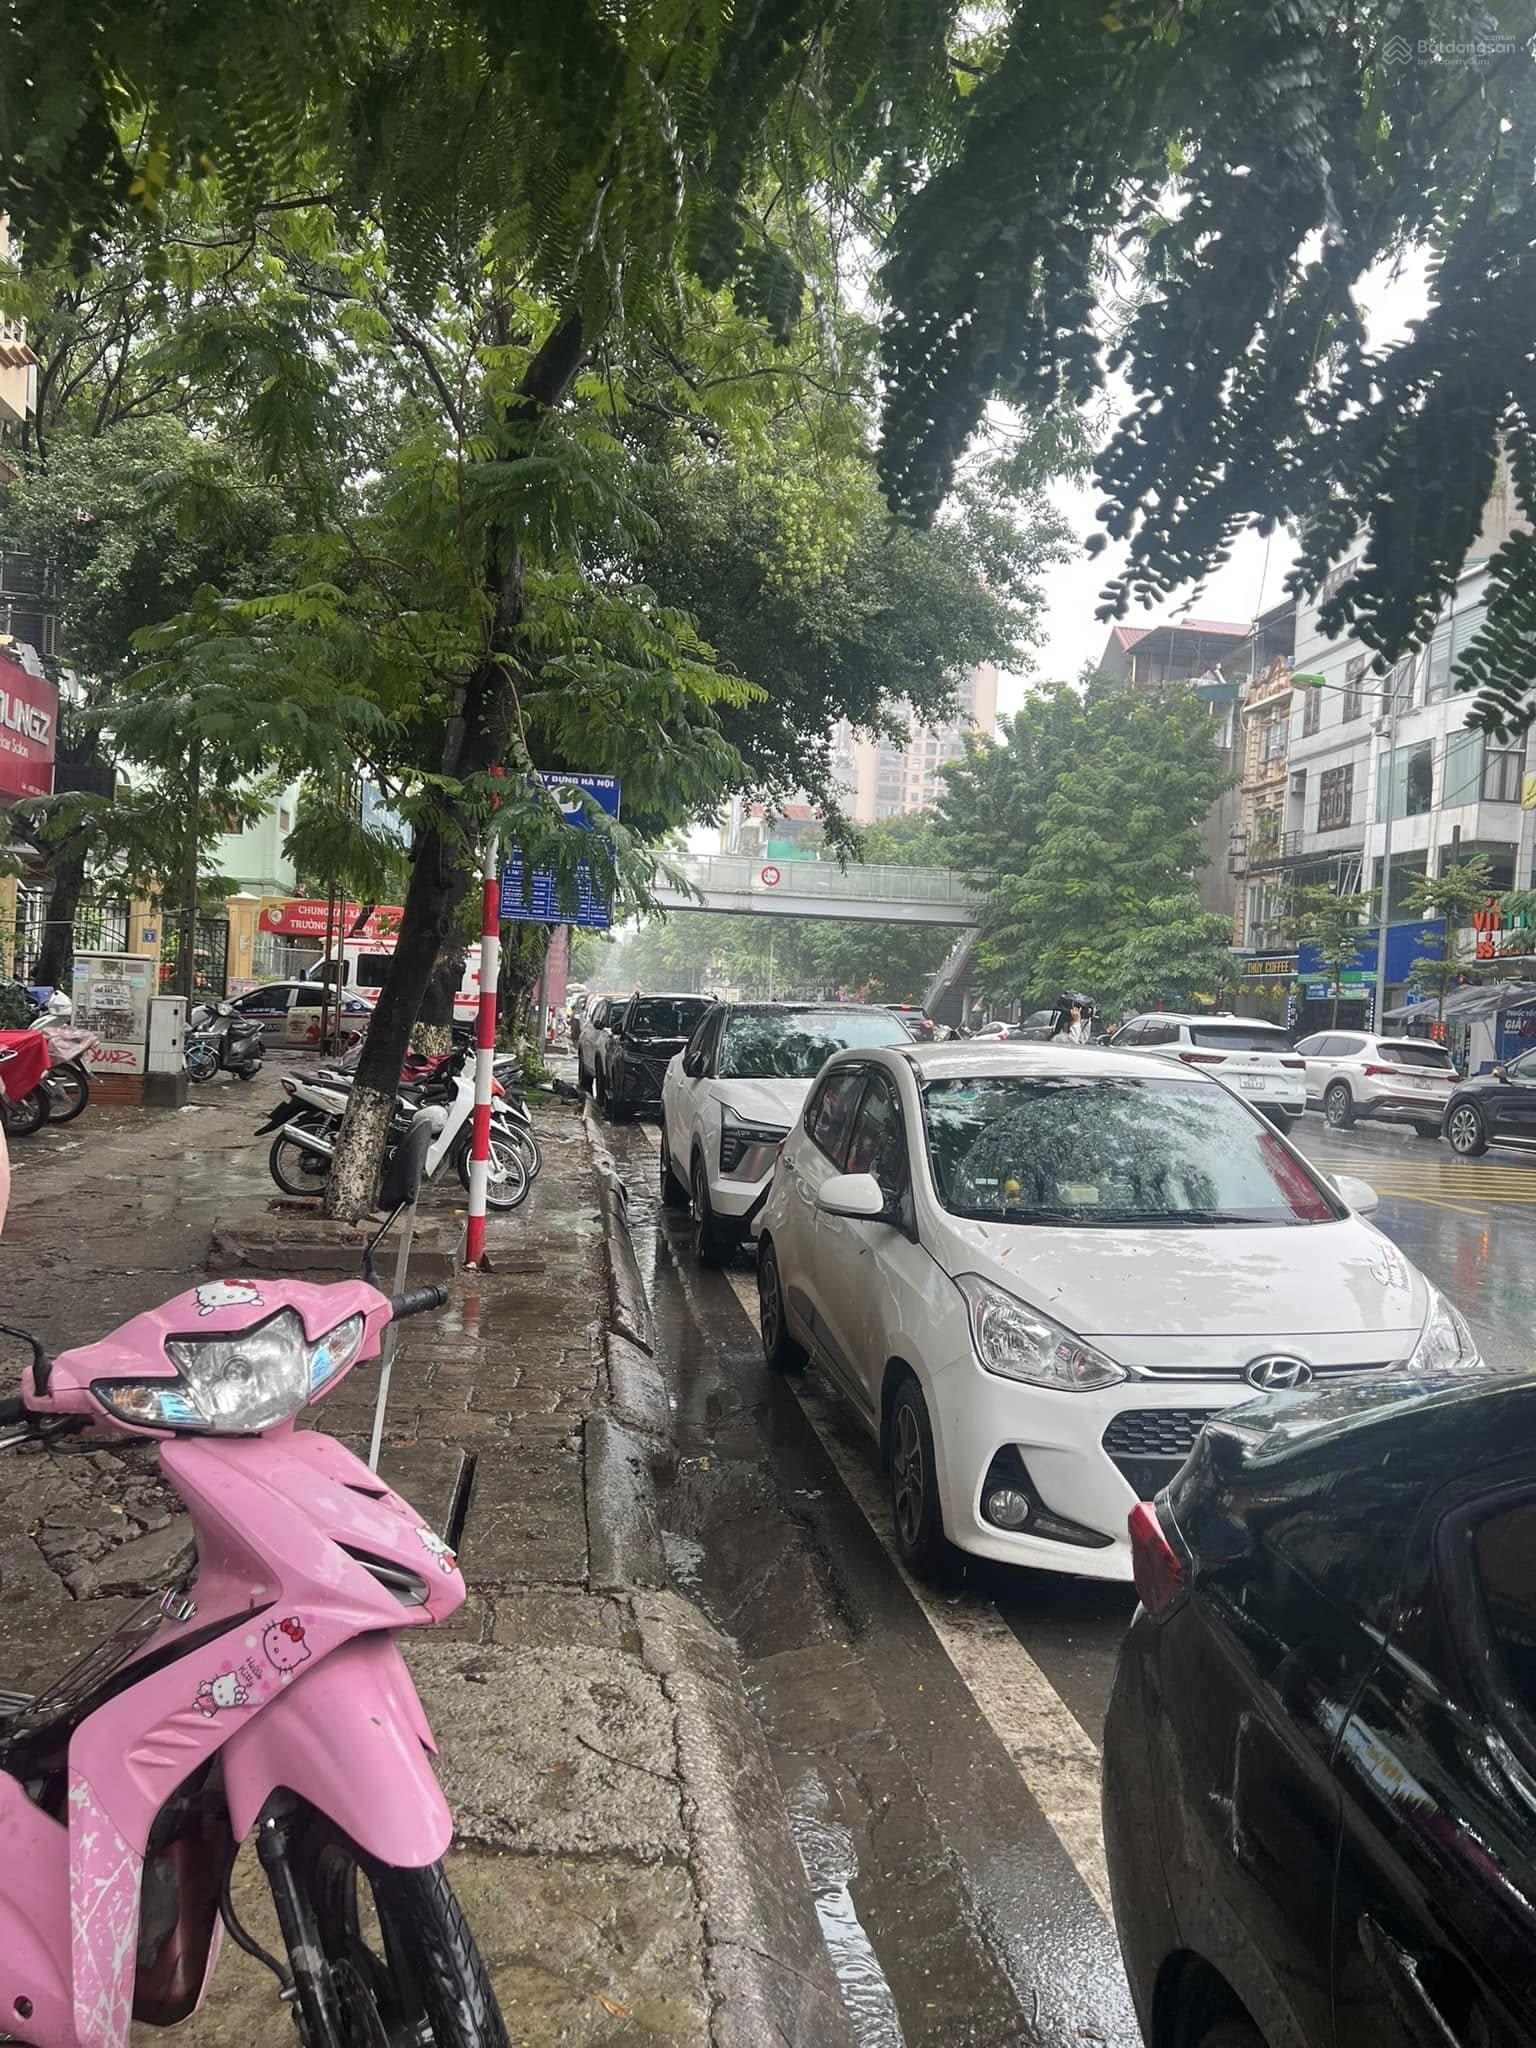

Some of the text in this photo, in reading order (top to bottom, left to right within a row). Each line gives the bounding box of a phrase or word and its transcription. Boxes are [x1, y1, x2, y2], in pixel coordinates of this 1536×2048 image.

[552, 774, 579, 785] DỰNG
[581, 776, 594, 786] HÀ
[597, 778, 615, 788] NỘI
[298, 905, 329, 917] CHUNG
[290, 917, 328, 931] TRƯỜNG
[1265, 959, 1289, 973] COFFEE
[246, 1656, 263, 1680] Hello
[238, 1664, 255, 1688] Kitty
